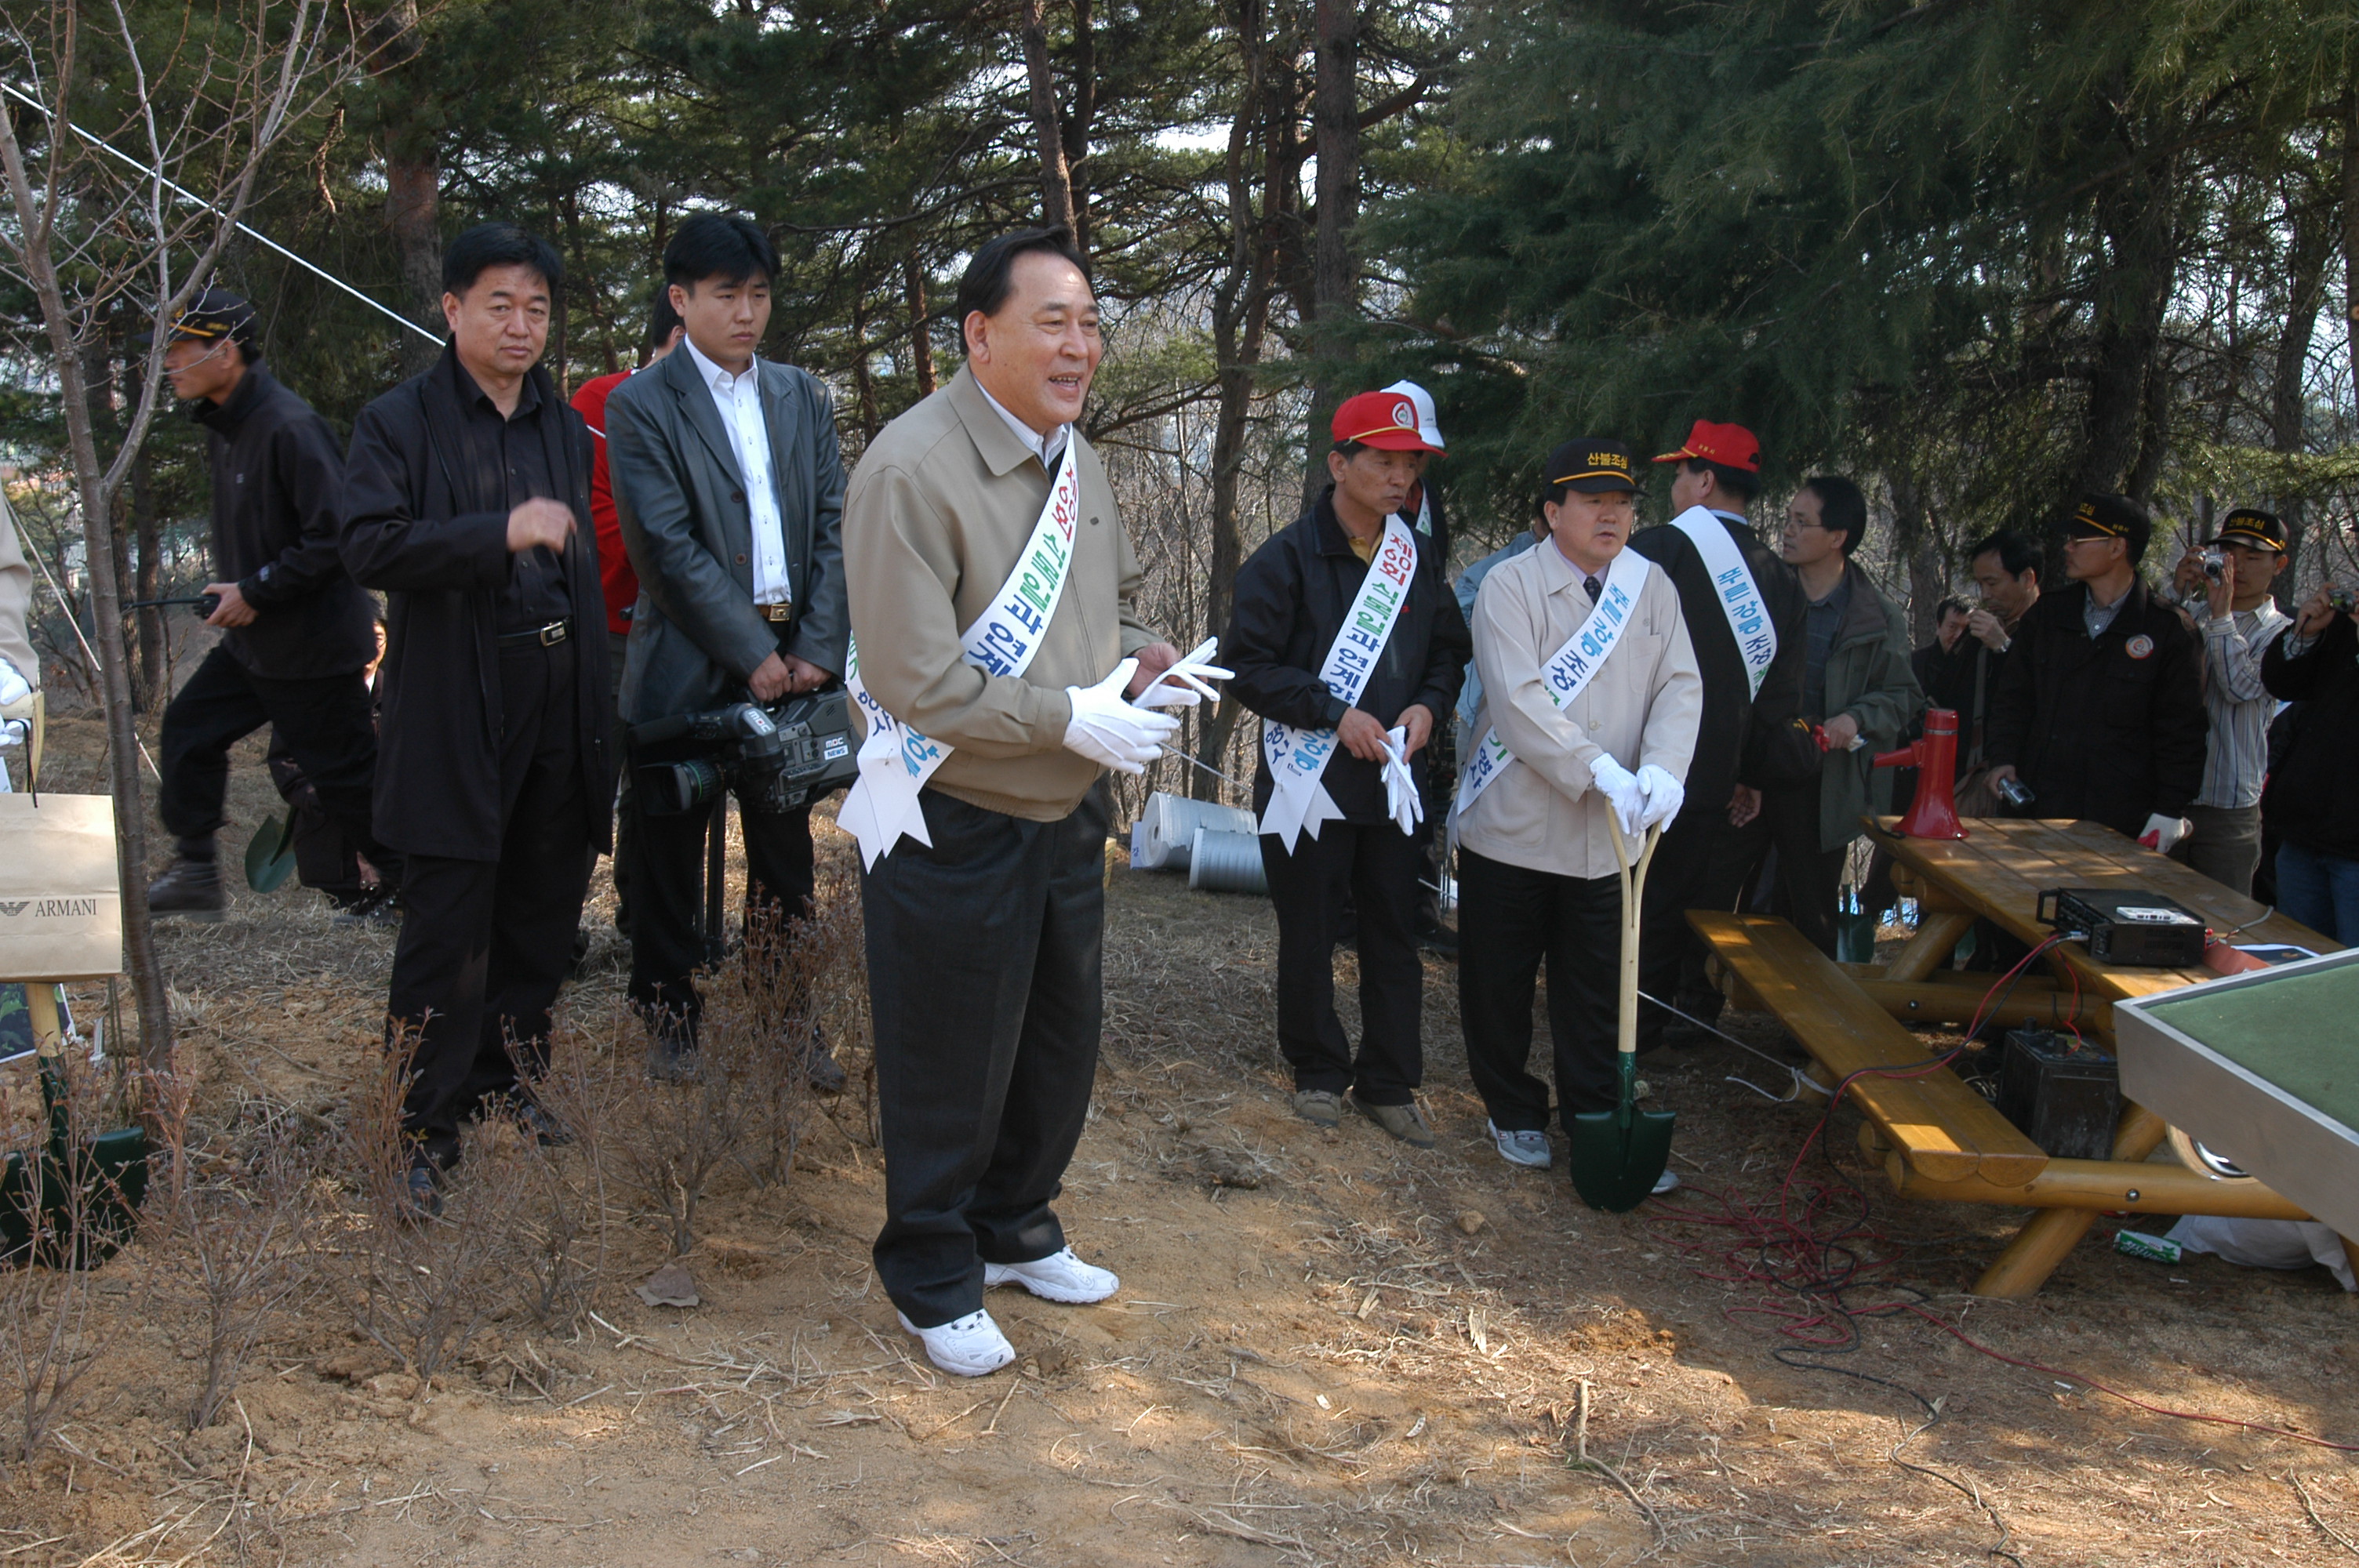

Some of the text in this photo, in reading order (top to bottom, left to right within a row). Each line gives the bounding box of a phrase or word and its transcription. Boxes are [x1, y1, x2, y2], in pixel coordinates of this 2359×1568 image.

[1587, 452, 1627, 469] 산불조심
[1052, 462, 1078, 543] 제60회
[2229, 517, 2265, 530] 산불조심
[1379, 533, 1412, 586] 제60회
[1346, 582, 1399, 652] 식목일과
[1551, 649, 1589, 691] 조성
[827, 747, 845, 757] NEWS
[35, 899, 96, 917] ARMANI
